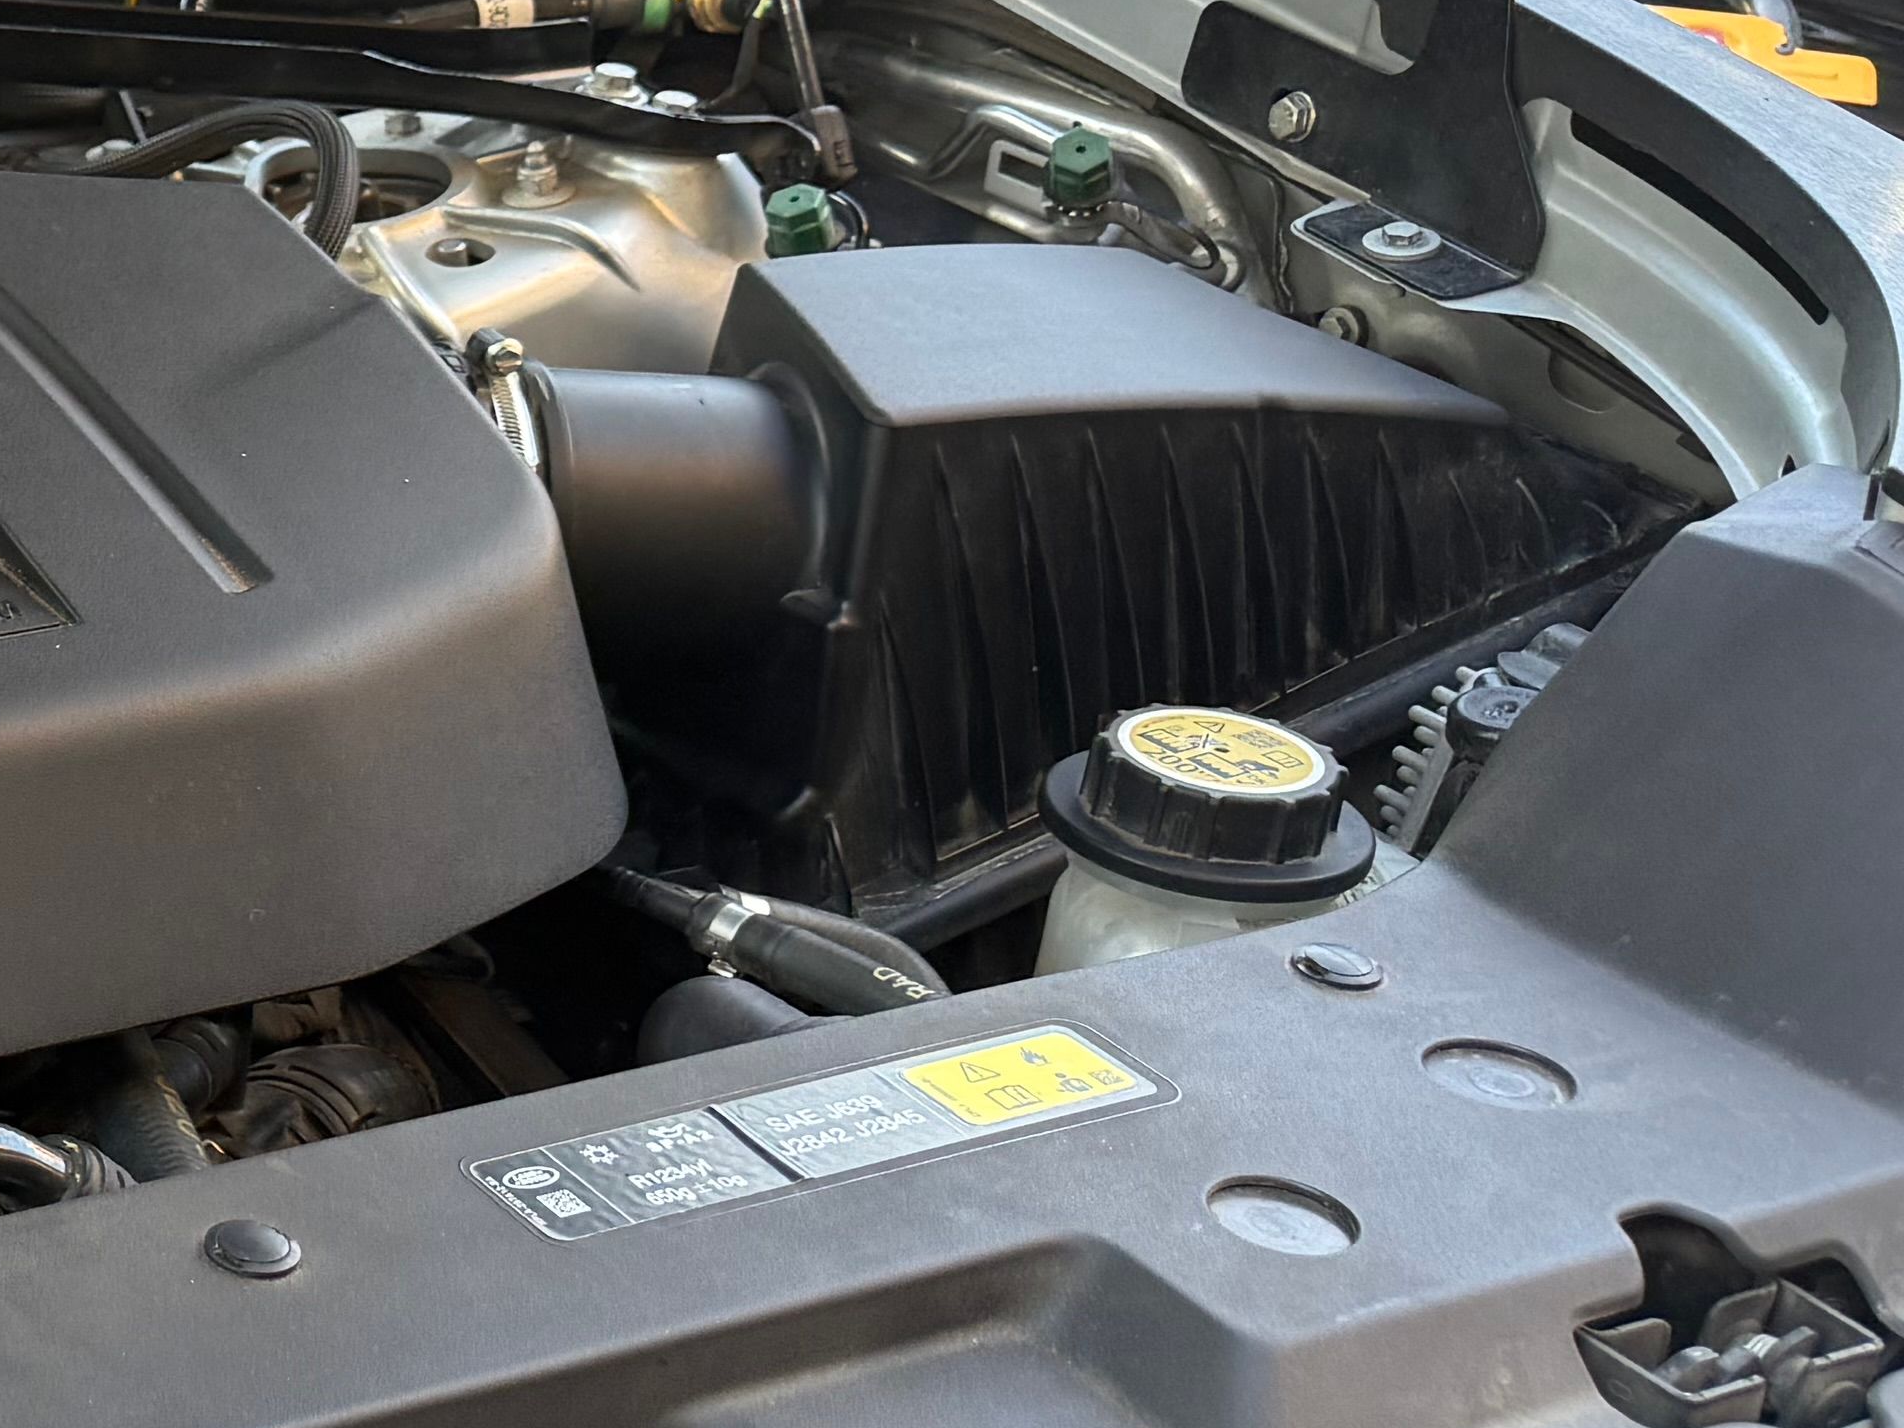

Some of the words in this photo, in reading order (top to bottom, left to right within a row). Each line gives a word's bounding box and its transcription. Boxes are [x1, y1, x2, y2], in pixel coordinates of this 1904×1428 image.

[765, 1108, 826, 1133] SAE
[825, 1094, 883, 1120] J639
[778, 1127, 855, 1157] J2842
[853, 1108, 927, 1138] J2845
[645, 1186, 697, 1206] 650g
